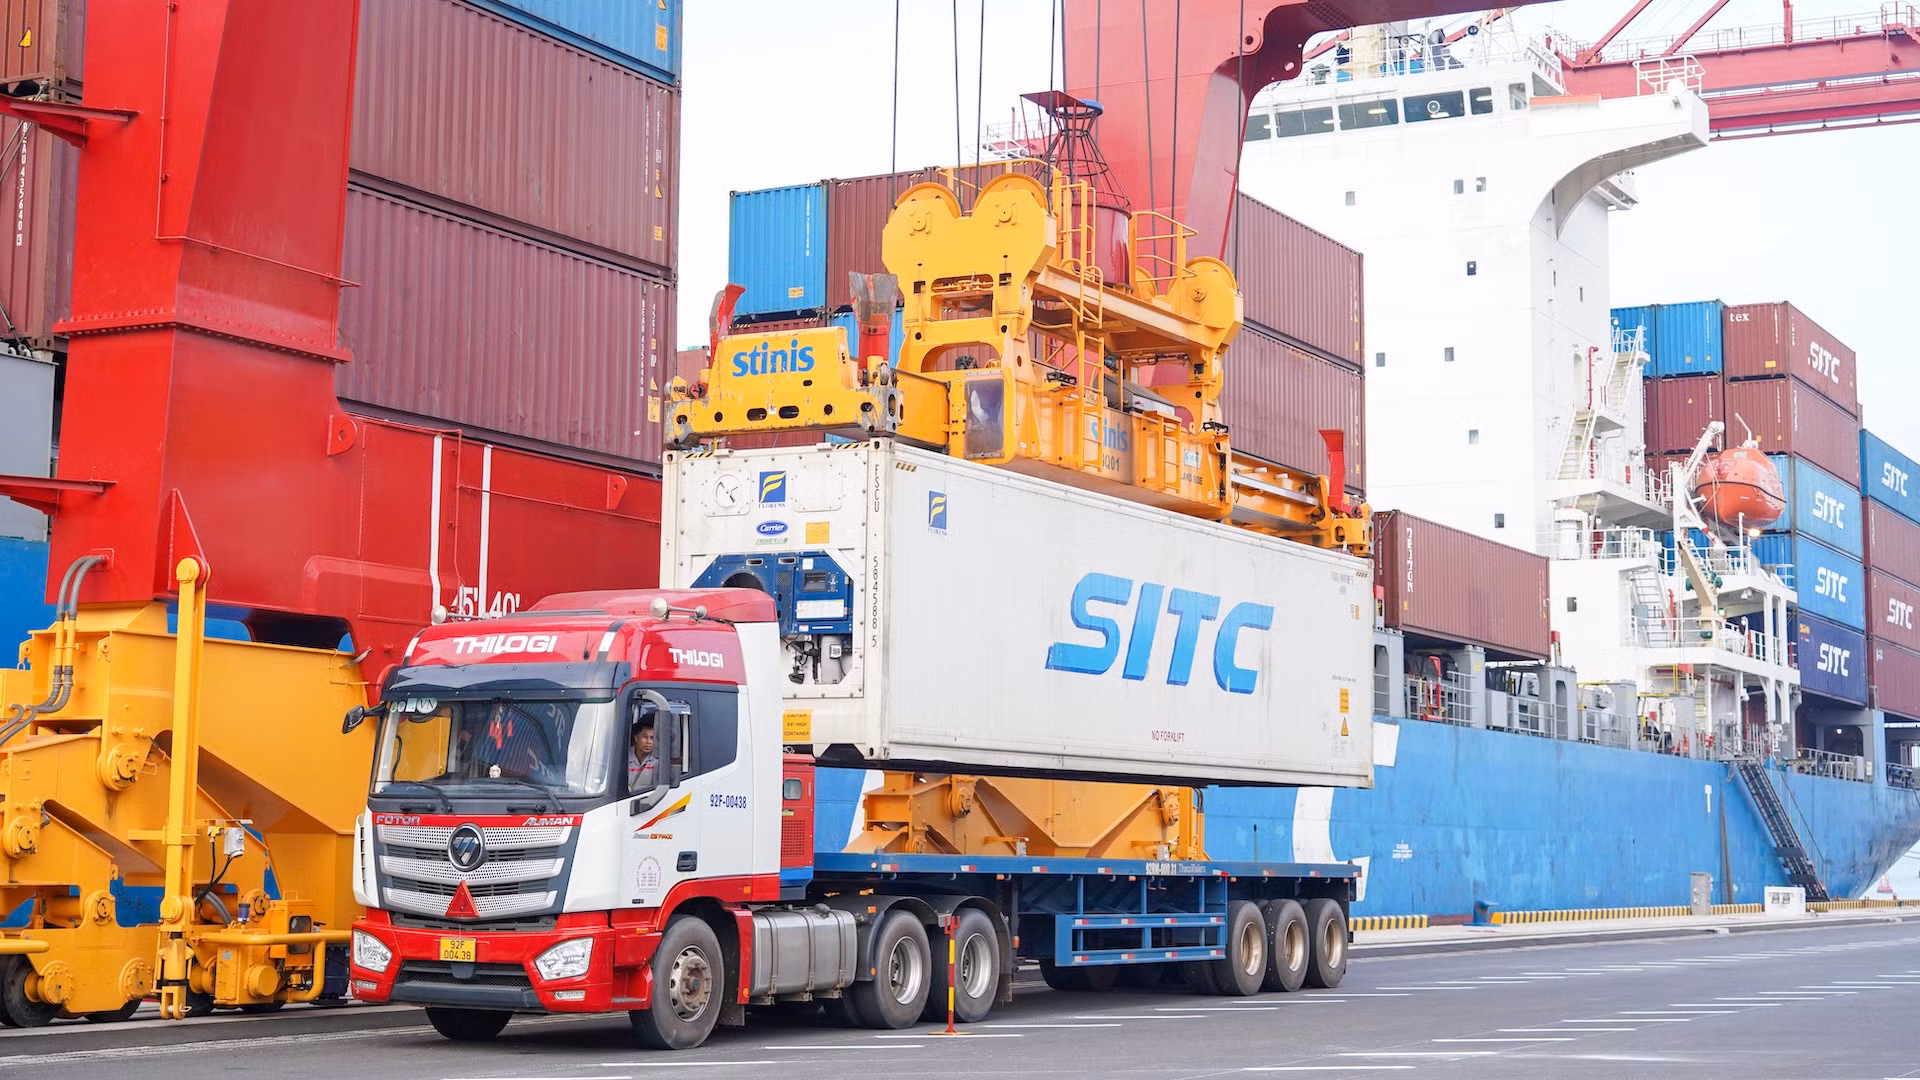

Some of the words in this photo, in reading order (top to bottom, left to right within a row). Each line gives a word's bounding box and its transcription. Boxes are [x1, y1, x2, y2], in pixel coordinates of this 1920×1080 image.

[17, 166, 26, 231] 435640
[1729, 312, 1750, 322] tex
[732, 338, 815, 377] stinis
[1807, 340, 1841, 385] SITC
[1091, 417, 1129, 453] sinis
[1881, 461, 1909, 497] SITC
[1812, 490, 1845, 530] SITC
[760, 523, 786, 533] Carrier
[1814, 566, 1848, 603] SITC
[1886, 597, 1914, 630] SITC
[453, 634, 558, 655] THILOGI
[872, 635, 878, 648] 5
[1045, 571, 1275, 695] SITC
[668, 647, 724, 669] THILOGI
[1817, 642, 1851, 678] SITC
[1151, 729, 1160, 741] NO
[1160, 730, 1185, 743] FORKLIFT
[709, 794, 747, 809] 92F-00438
[376, 815, 421, 825] FOTON
[443, 949, 472, 960] 004.38
[450, 940, 465, 950] 92F
